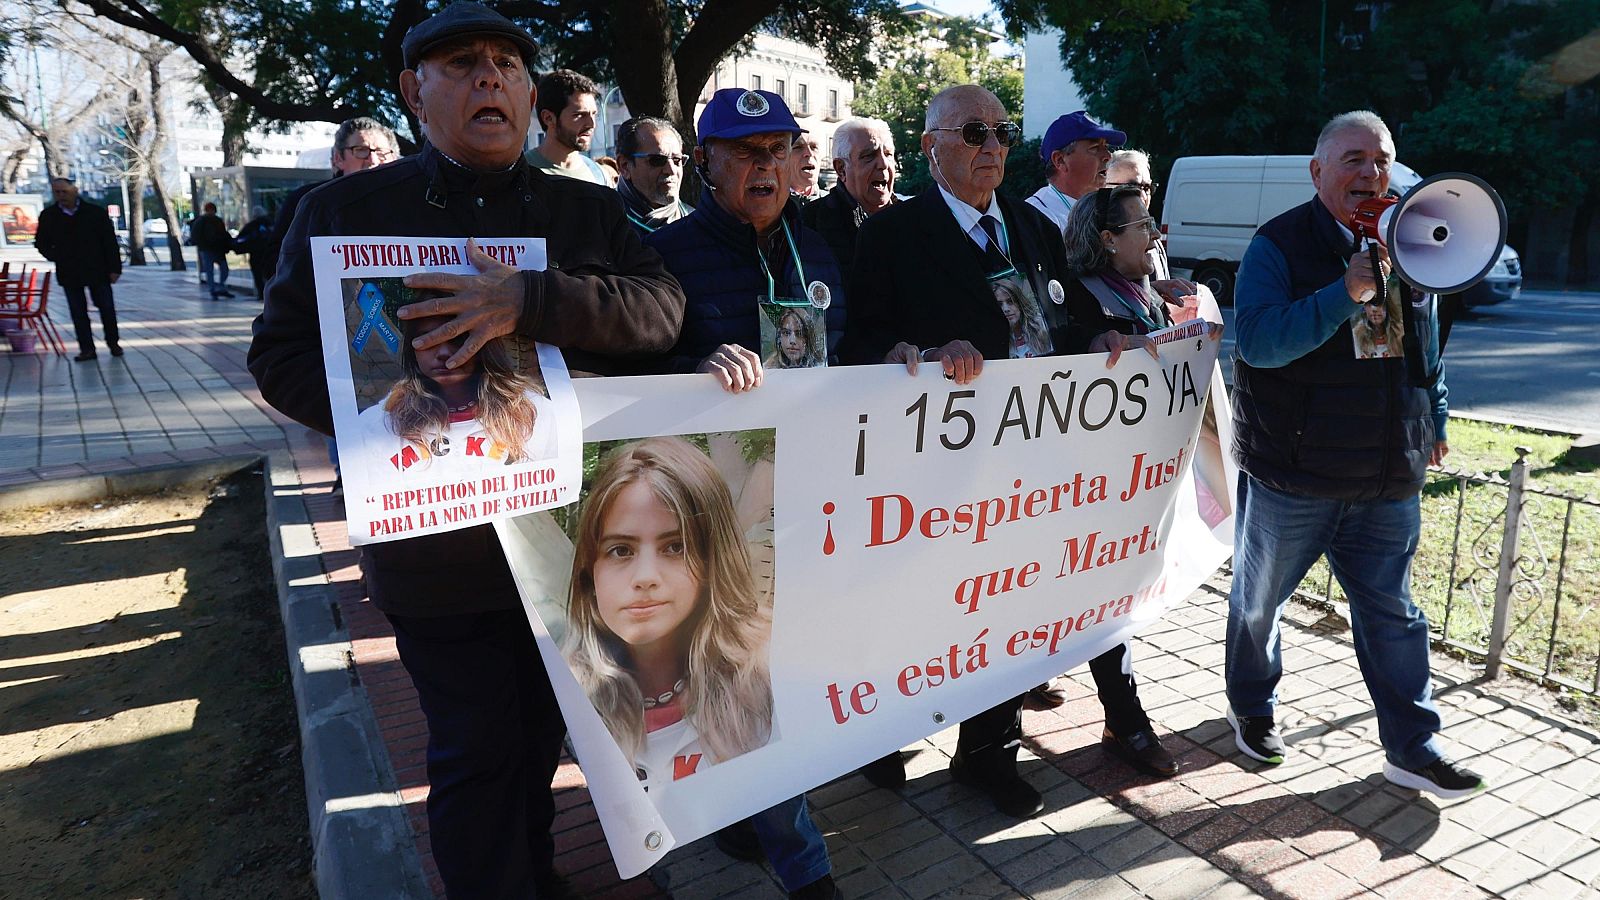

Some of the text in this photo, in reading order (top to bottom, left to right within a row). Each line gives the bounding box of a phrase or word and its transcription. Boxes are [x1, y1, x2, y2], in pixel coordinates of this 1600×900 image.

[417, 245, 461, 266] PARA
[368, 299, 381, 320] SOMOS
[905, 390, 976, 453] 15
[993, 370, 1149, 446] AÑOS
[382, 480, 476, 511] REPETICIÓN
[481, 475, 509, 495] DEL
[513, 468, 556, 491] JUICIO
[864, 474, 1108, 549] Despierta
[369, 516, 413, 537] PARA
[419, 511, 438, 528] LA
[443, 502, 477, 524] NIÑA
[482, 498, 501, 516] DE
[953, 561, 1040, 615] que
[826, 681, 878, 725] te
[897, 628, 990, 697] está
